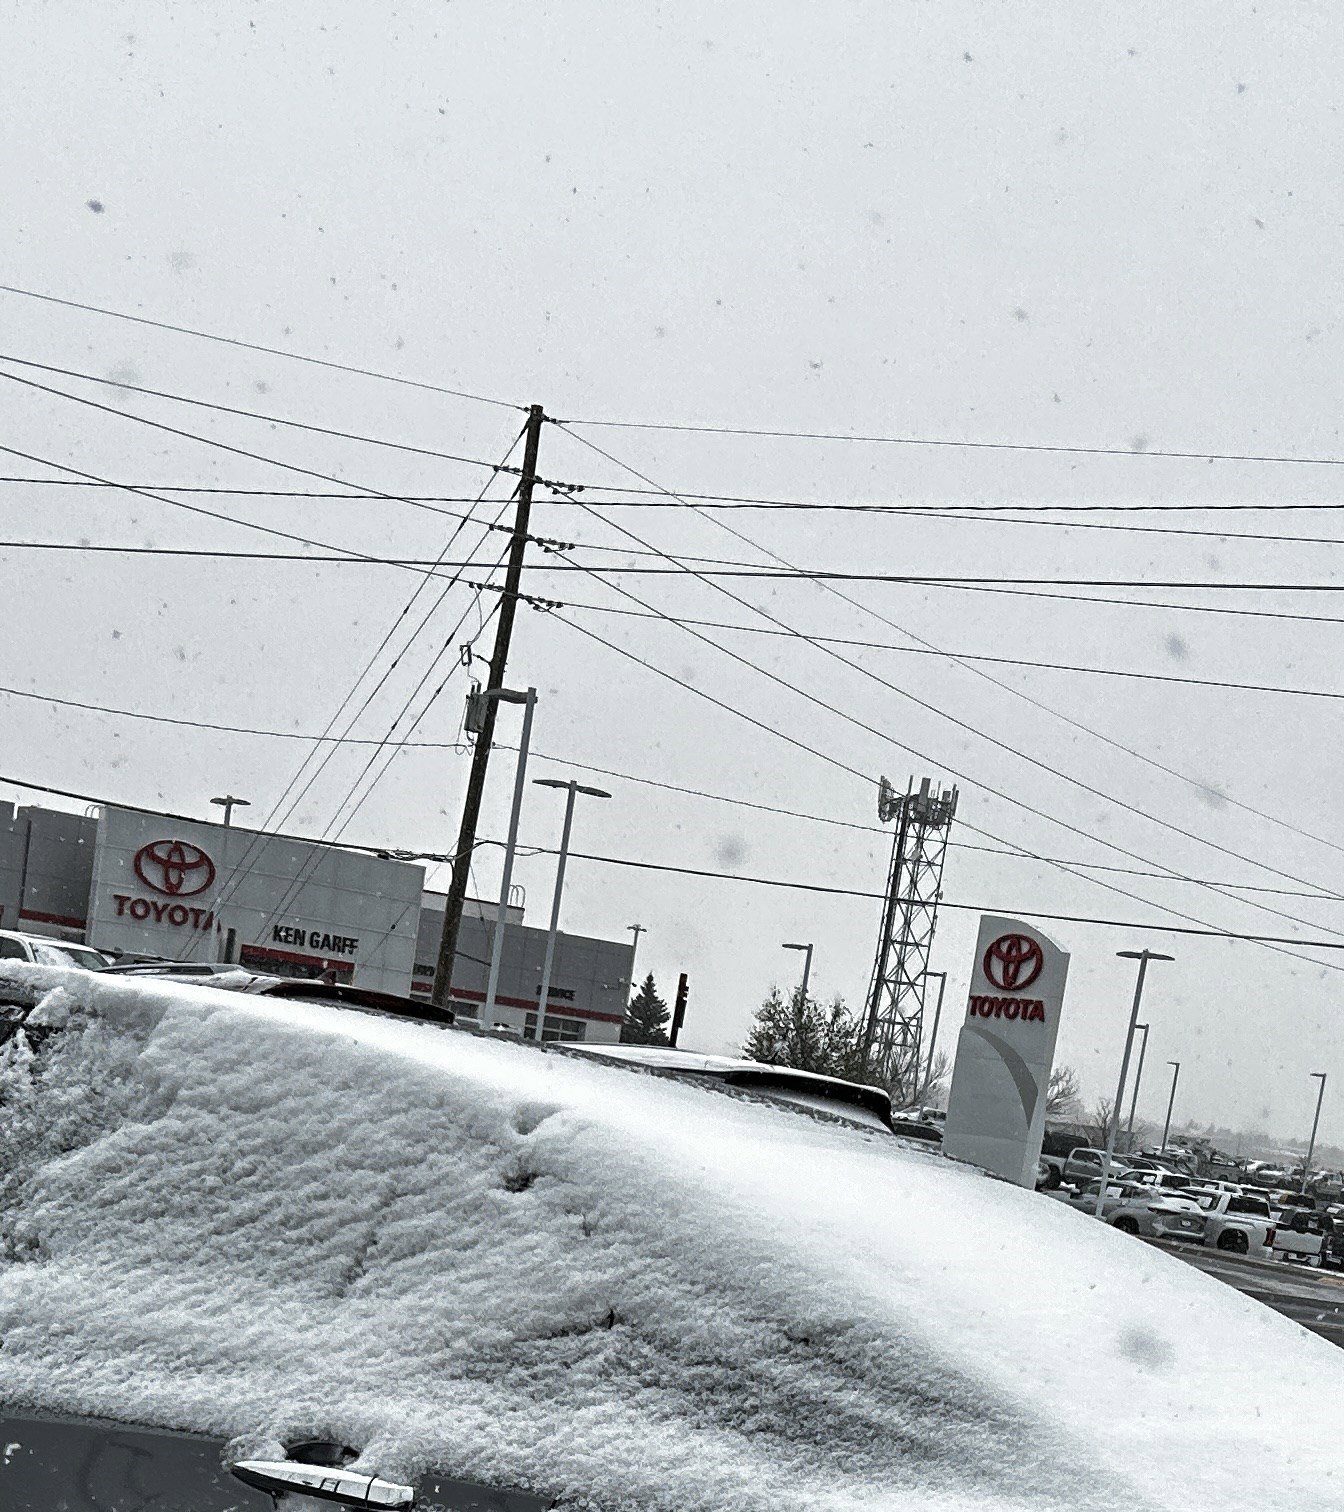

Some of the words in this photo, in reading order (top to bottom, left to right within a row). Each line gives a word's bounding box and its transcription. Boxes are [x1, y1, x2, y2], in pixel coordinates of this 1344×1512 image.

[113, 893, 222, 934] TOYOTA
[272, 924, 306, 947] KEN
[309, 931, 359, 955] GARFF
[968, 995, 1045, 1023] TOYOTA
